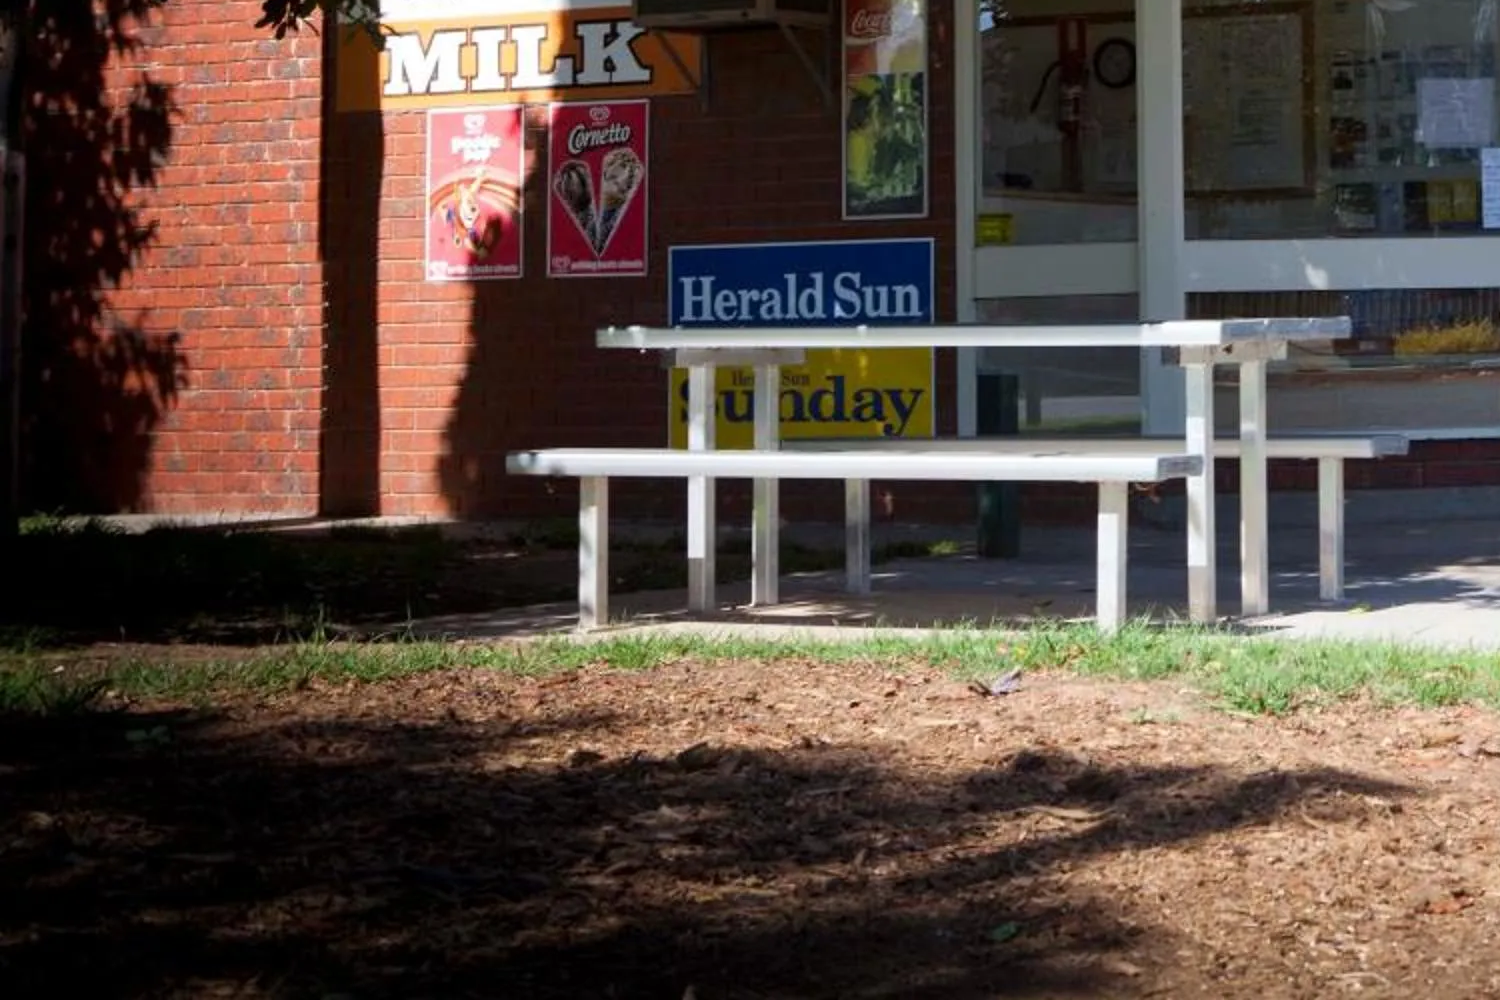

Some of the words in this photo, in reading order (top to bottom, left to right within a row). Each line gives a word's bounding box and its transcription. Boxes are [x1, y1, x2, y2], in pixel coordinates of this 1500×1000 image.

[383, 18, 653, 96] MILK
[568, 123, 630, 155] Cornetto
[679, 272, 826, 321] Herald
[833, 271, 923, 319] Sun
[781, 371, 810, 386] Sun
